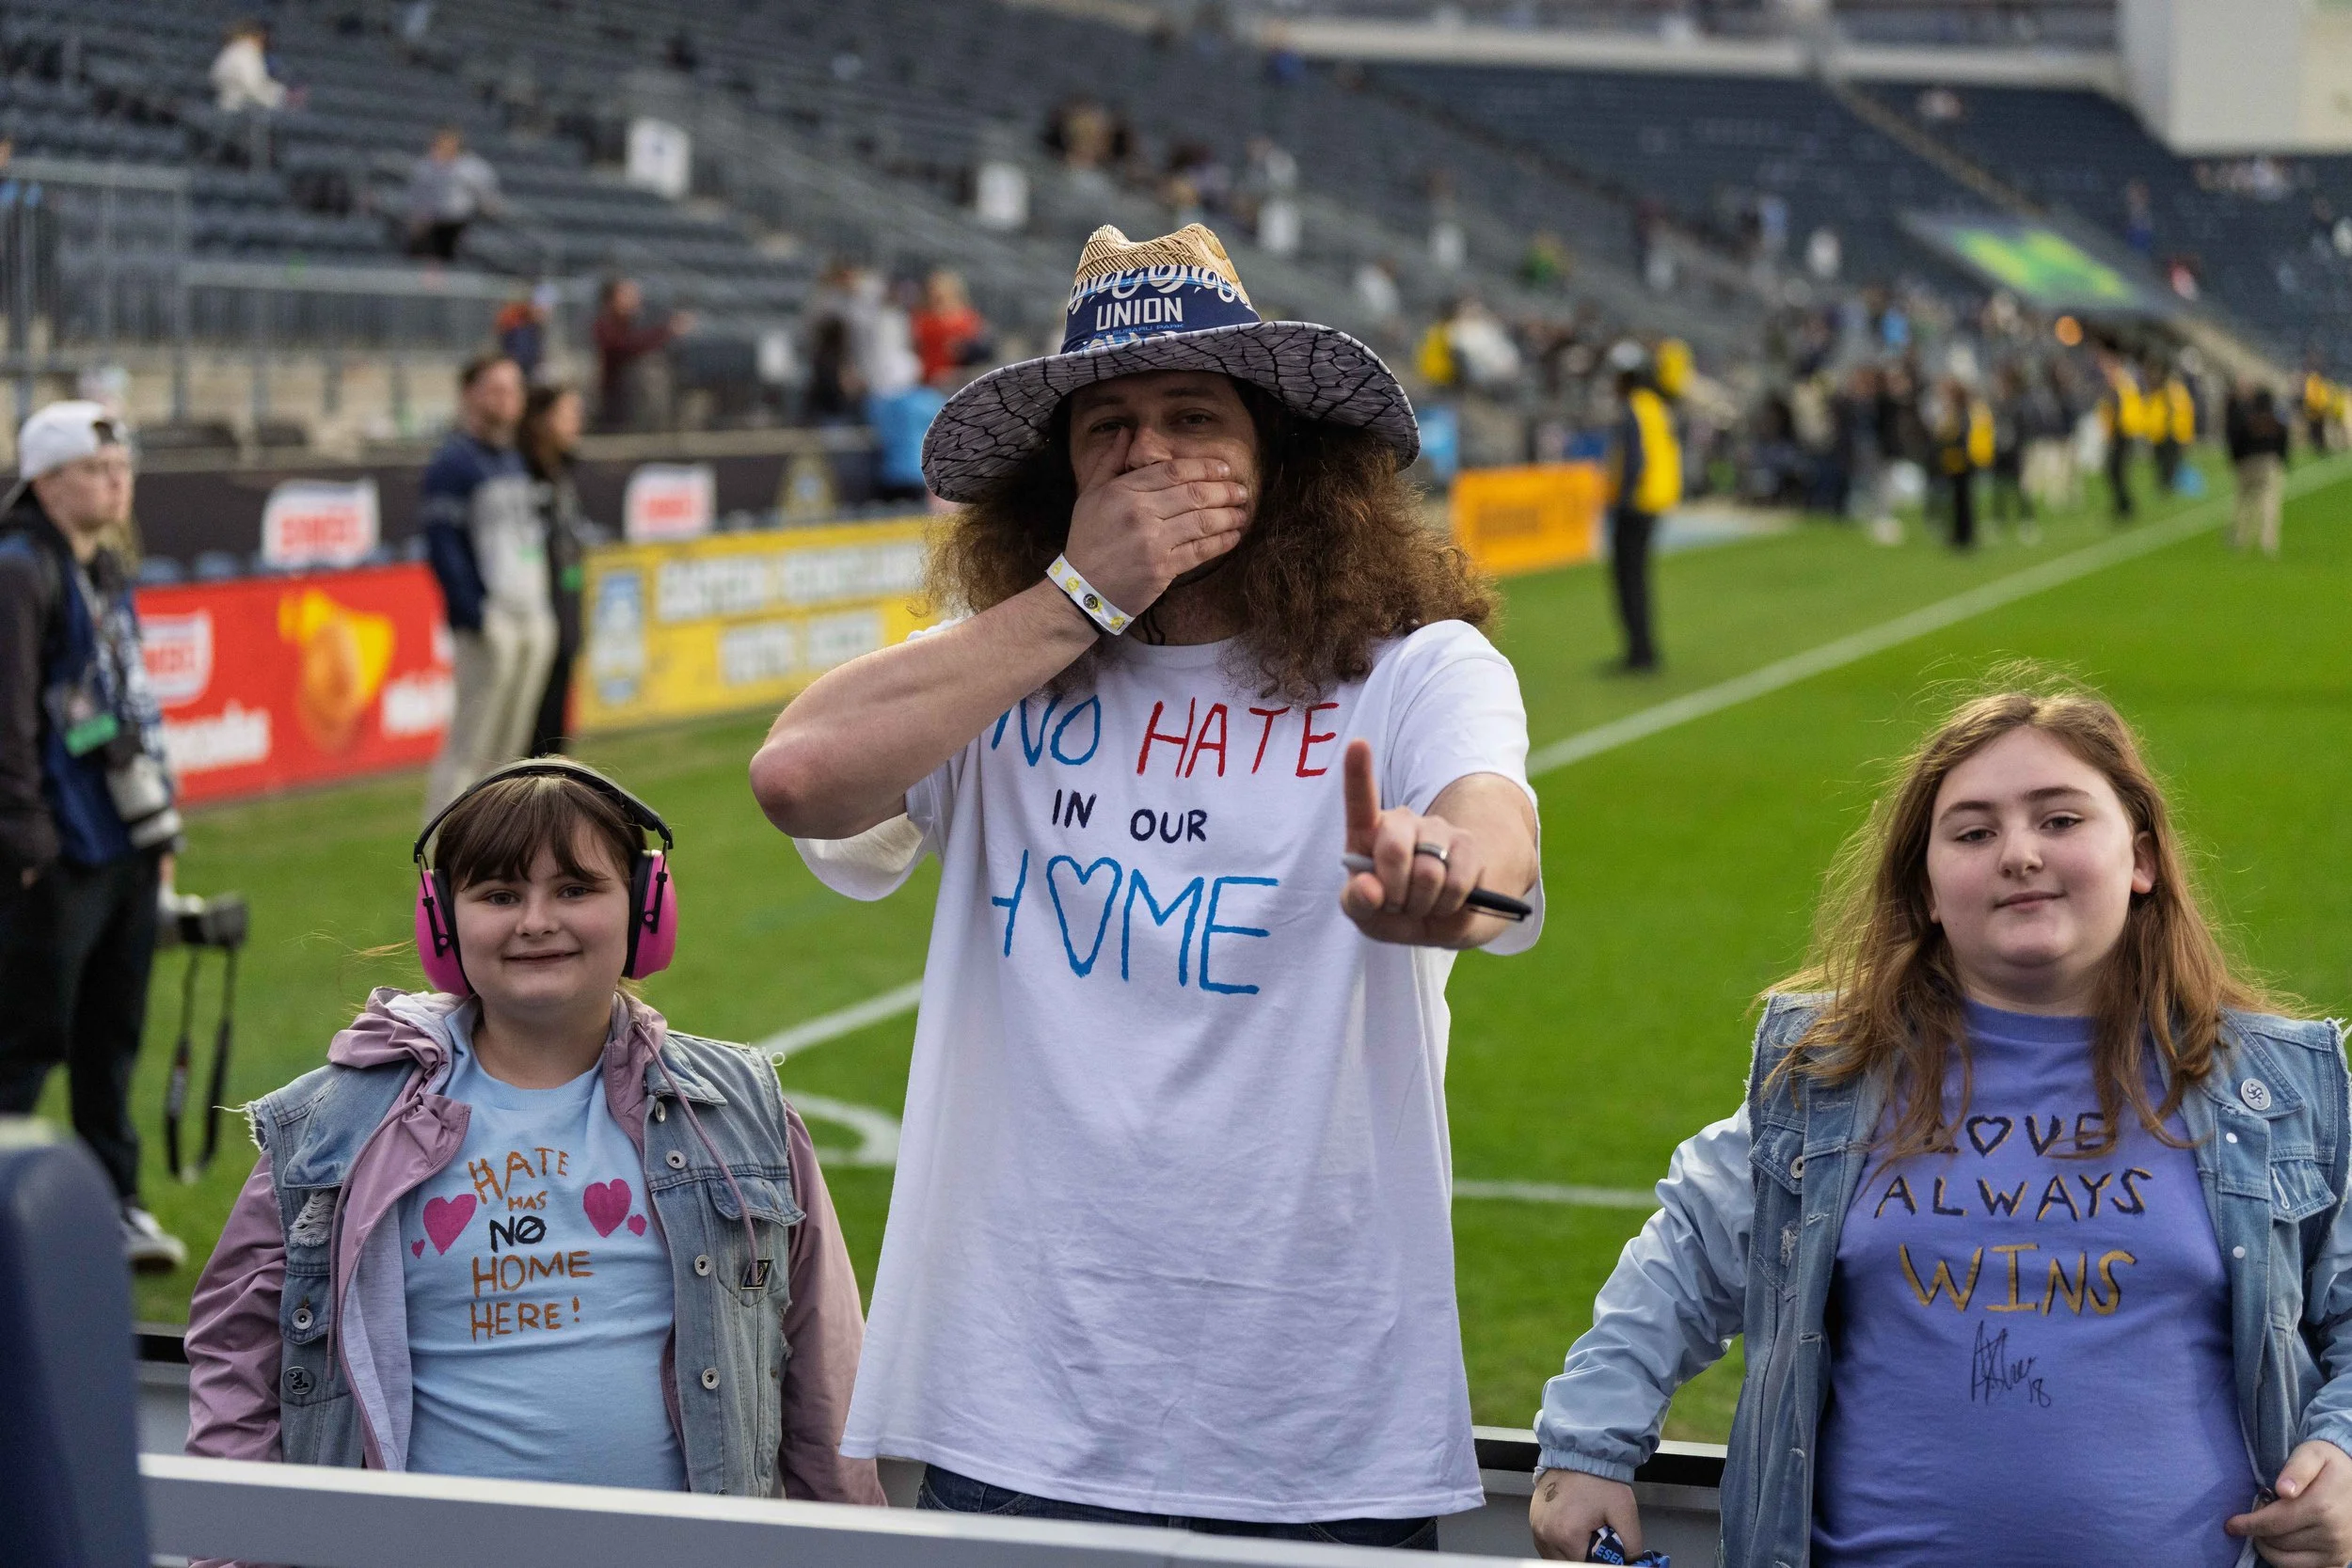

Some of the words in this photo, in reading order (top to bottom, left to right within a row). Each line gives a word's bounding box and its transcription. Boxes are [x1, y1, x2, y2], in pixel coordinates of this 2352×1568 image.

[1096, 296, 1184, 331] UNION
[991, 693, 1102, 768] NO
[1136, 697, 1340, 779] HATE
[1051, 788, 1097, 829] IN
[1130, 808, 1208, 844] OUR
[468, 1147, 570, 1205] HATE
[507, 1190, 548, 1212] HAS
[1874, 1166, 2153, 1223] ALWAYS
[472, 1250, 596, 1300] HOME
[1899, 1243, 2137, 1317] WINS
[469, 1294, 580, 1343] HERE!
